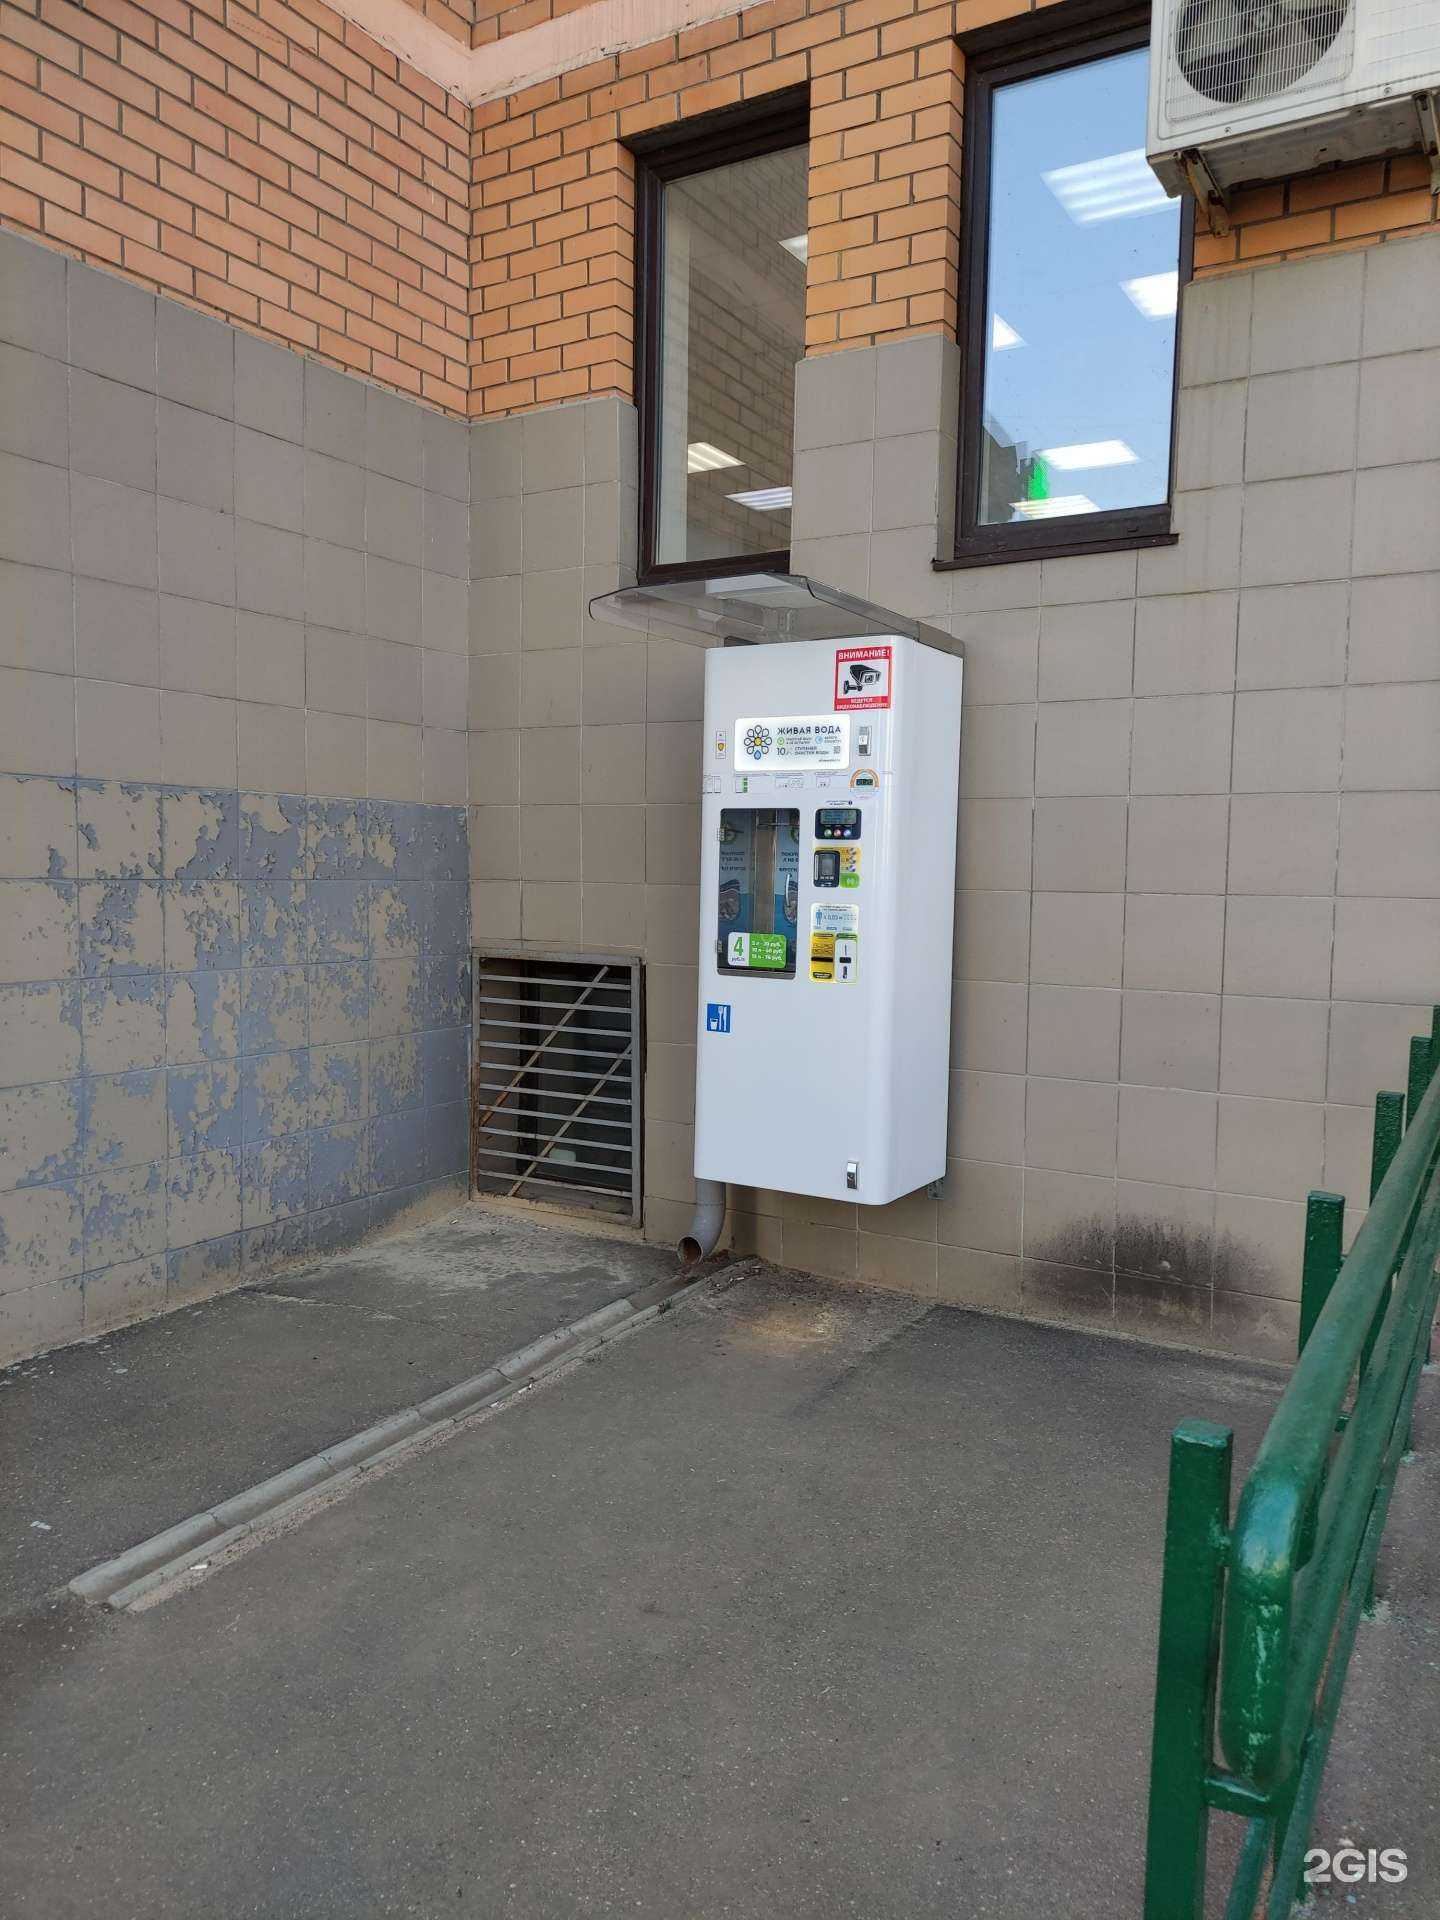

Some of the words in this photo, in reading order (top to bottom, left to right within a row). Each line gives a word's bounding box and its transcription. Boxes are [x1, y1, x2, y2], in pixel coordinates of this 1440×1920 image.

[838, 649, 890, 660] ВНИМАНИЕ!
[777, 726, 812, 735] ЖИВАЯ
[814, 725, 842, 735] ВОДА
[777, 747, 786, 756] 10
[734, 936, 744, 957] 4
